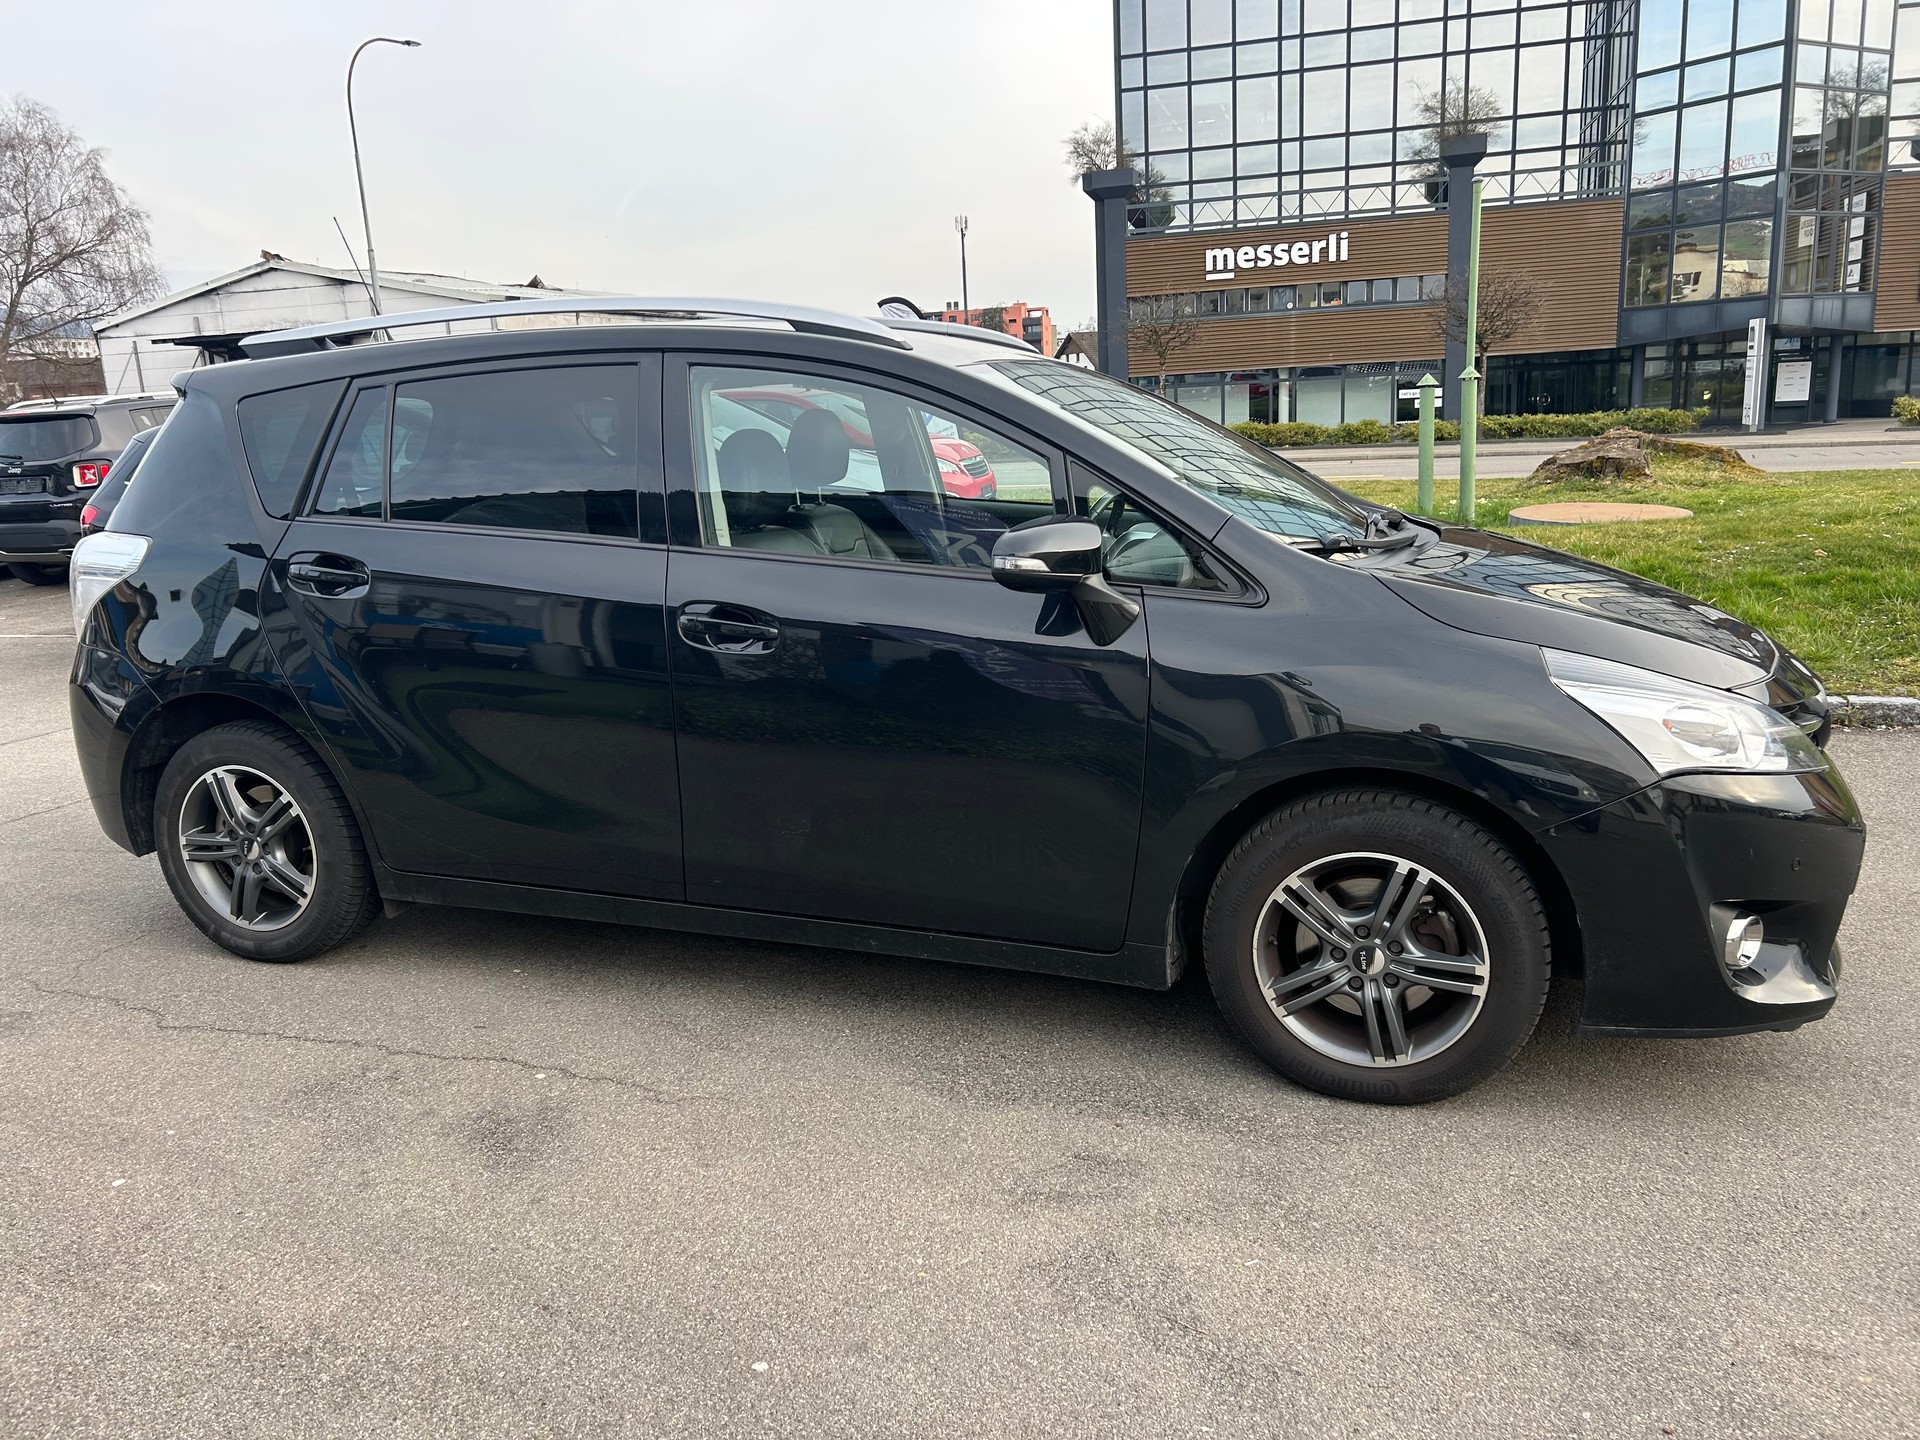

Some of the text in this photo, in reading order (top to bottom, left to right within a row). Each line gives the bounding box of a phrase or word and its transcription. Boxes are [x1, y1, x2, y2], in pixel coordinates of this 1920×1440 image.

[1206, 231, 1349, 273] messerli
[8, 466, 22, 475] Jeep
[1359, 950, 1367, 970] T-Line
